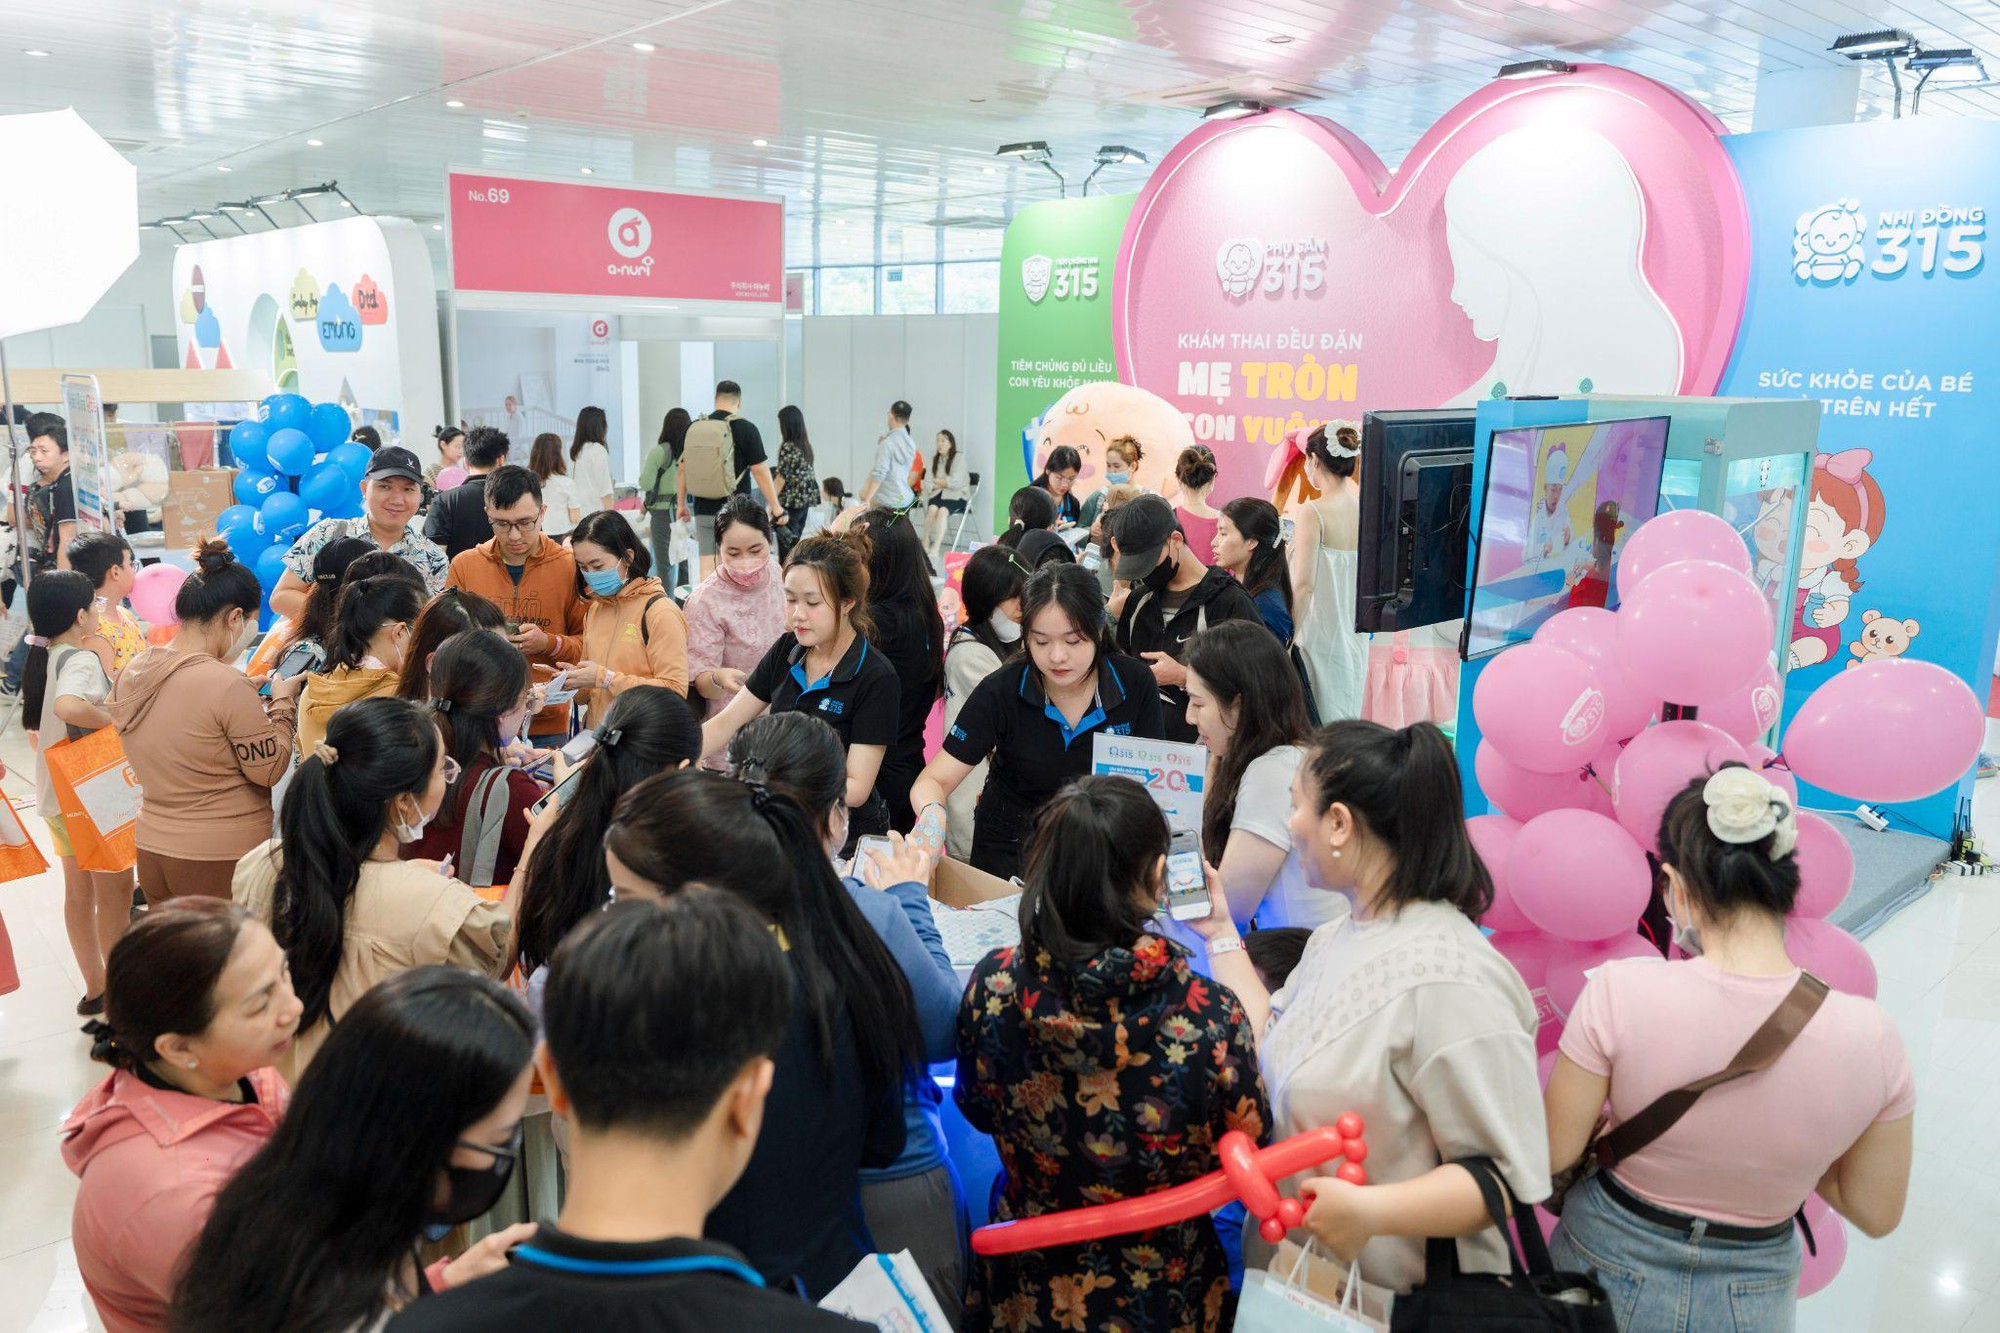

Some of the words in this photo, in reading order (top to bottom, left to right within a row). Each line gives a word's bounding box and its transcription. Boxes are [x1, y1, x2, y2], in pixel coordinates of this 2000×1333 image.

[469, 187, 509, 204] No.69
[1878, 210, 1914, 227] NHI
[1920, 203, 1985, 226] ĐỒNG
[1871, 225, 1985, 276] 315
[1053, 266, 1099, 298] 315
[1263, 255, 1327, 293] 315
[1178, 329, 1225, 350] KHÁM
[1230, 333, 1271, 350] THAI
[1276, 326, 1315, 350] ĐỀU
[1320, 328, 1363, 354] ĐẶN
[1010, 358, 1033, 372] TIÊM
[1035, 358, 1069, 373] CHỦNG
[1072, 358, 1087, 373] ĐỦ
[1089, 357, 1113, 373] LIỀU
[1008, 376, 1029, 388] CON
[1031, 375, 1051, 388] YÊU
[1178, 360, 1232, 406] MẸ
[1240, 353, 1359, 402] TRÒN
[1758, 367, 1803, 389] SỨC
[1809, 368, 1875, 390] KHỎE
[1881, 369, 1932, 392] CỦA
[1940, 371, 1975, 393] BÉ
[1820, 395, 1881, 417] TRÊN
[1888, 394, 1938, 419] HẾT
[231, 737, 277, 761] OND
